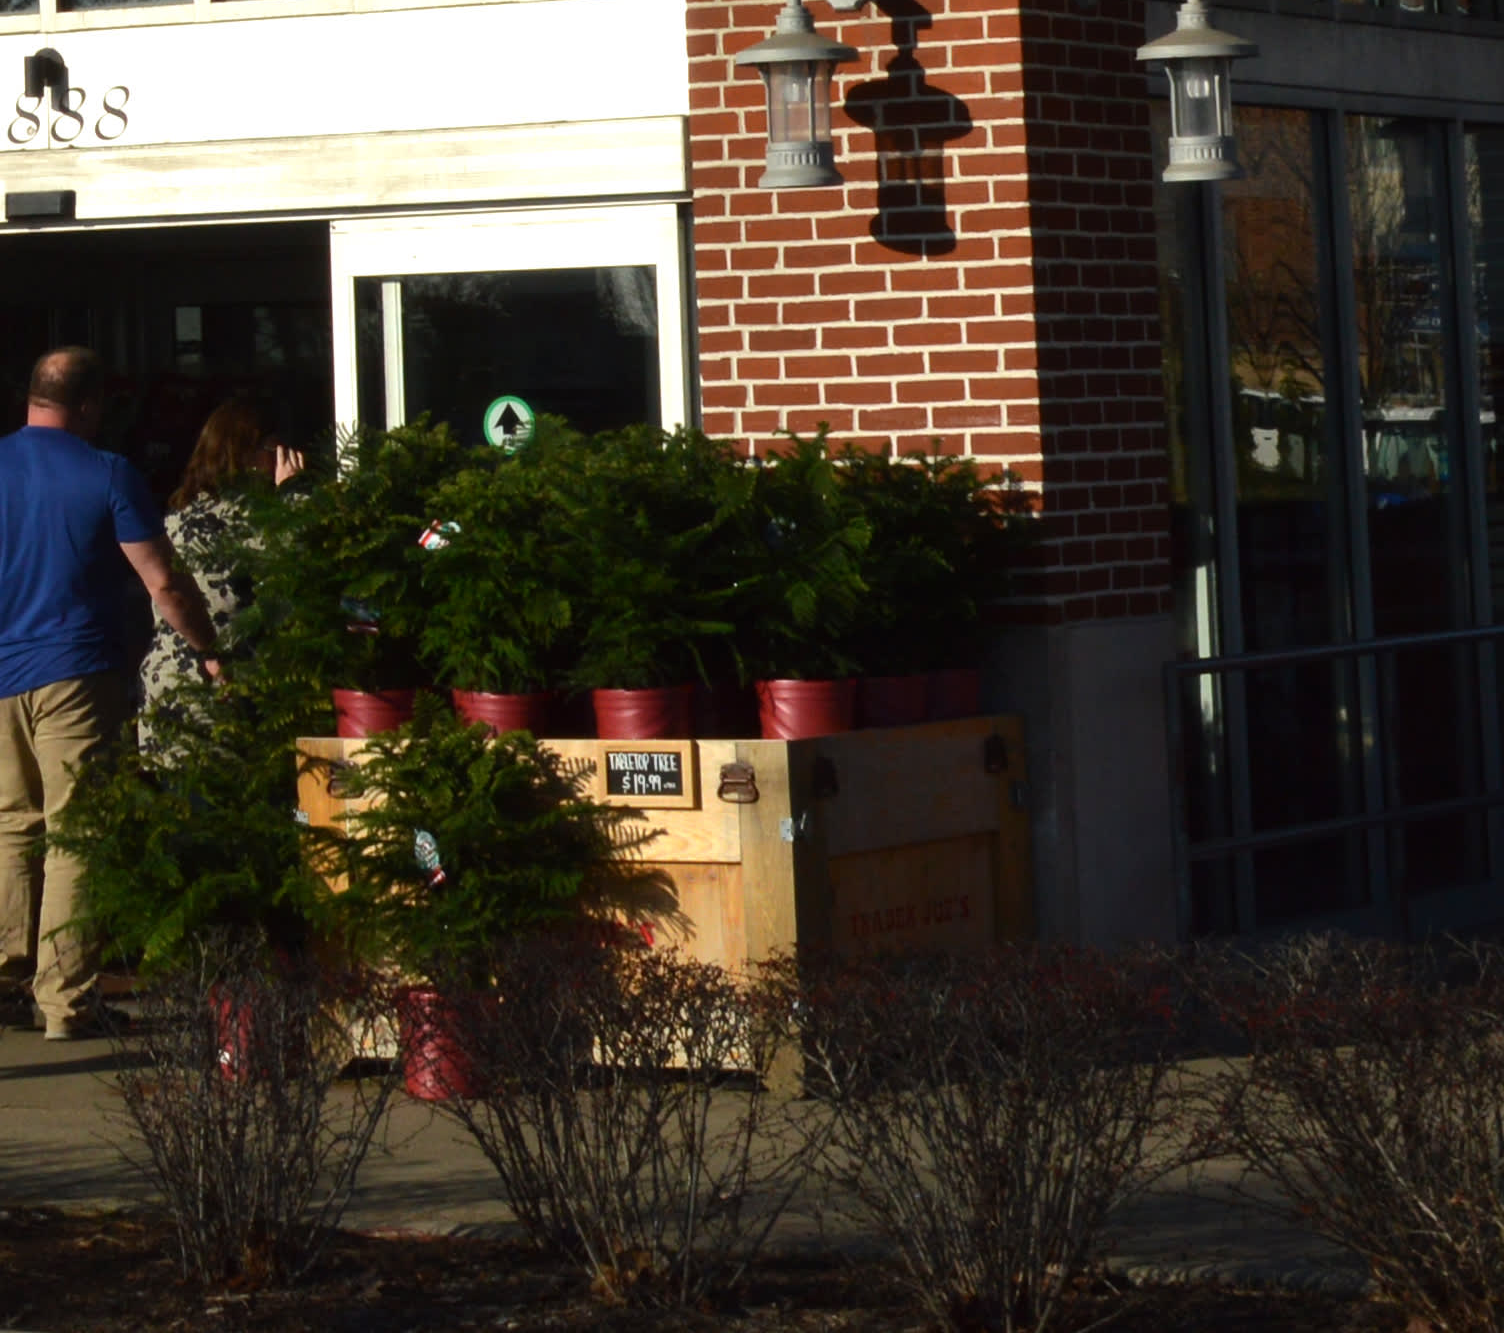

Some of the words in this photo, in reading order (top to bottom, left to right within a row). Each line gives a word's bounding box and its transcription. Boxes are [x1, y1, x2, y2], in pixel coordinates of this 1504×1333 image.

[608, 752, 650, 771] TABLETOP
[651, 753, 678, 772] TREE
[622, 771, 662, 794] $19.99
